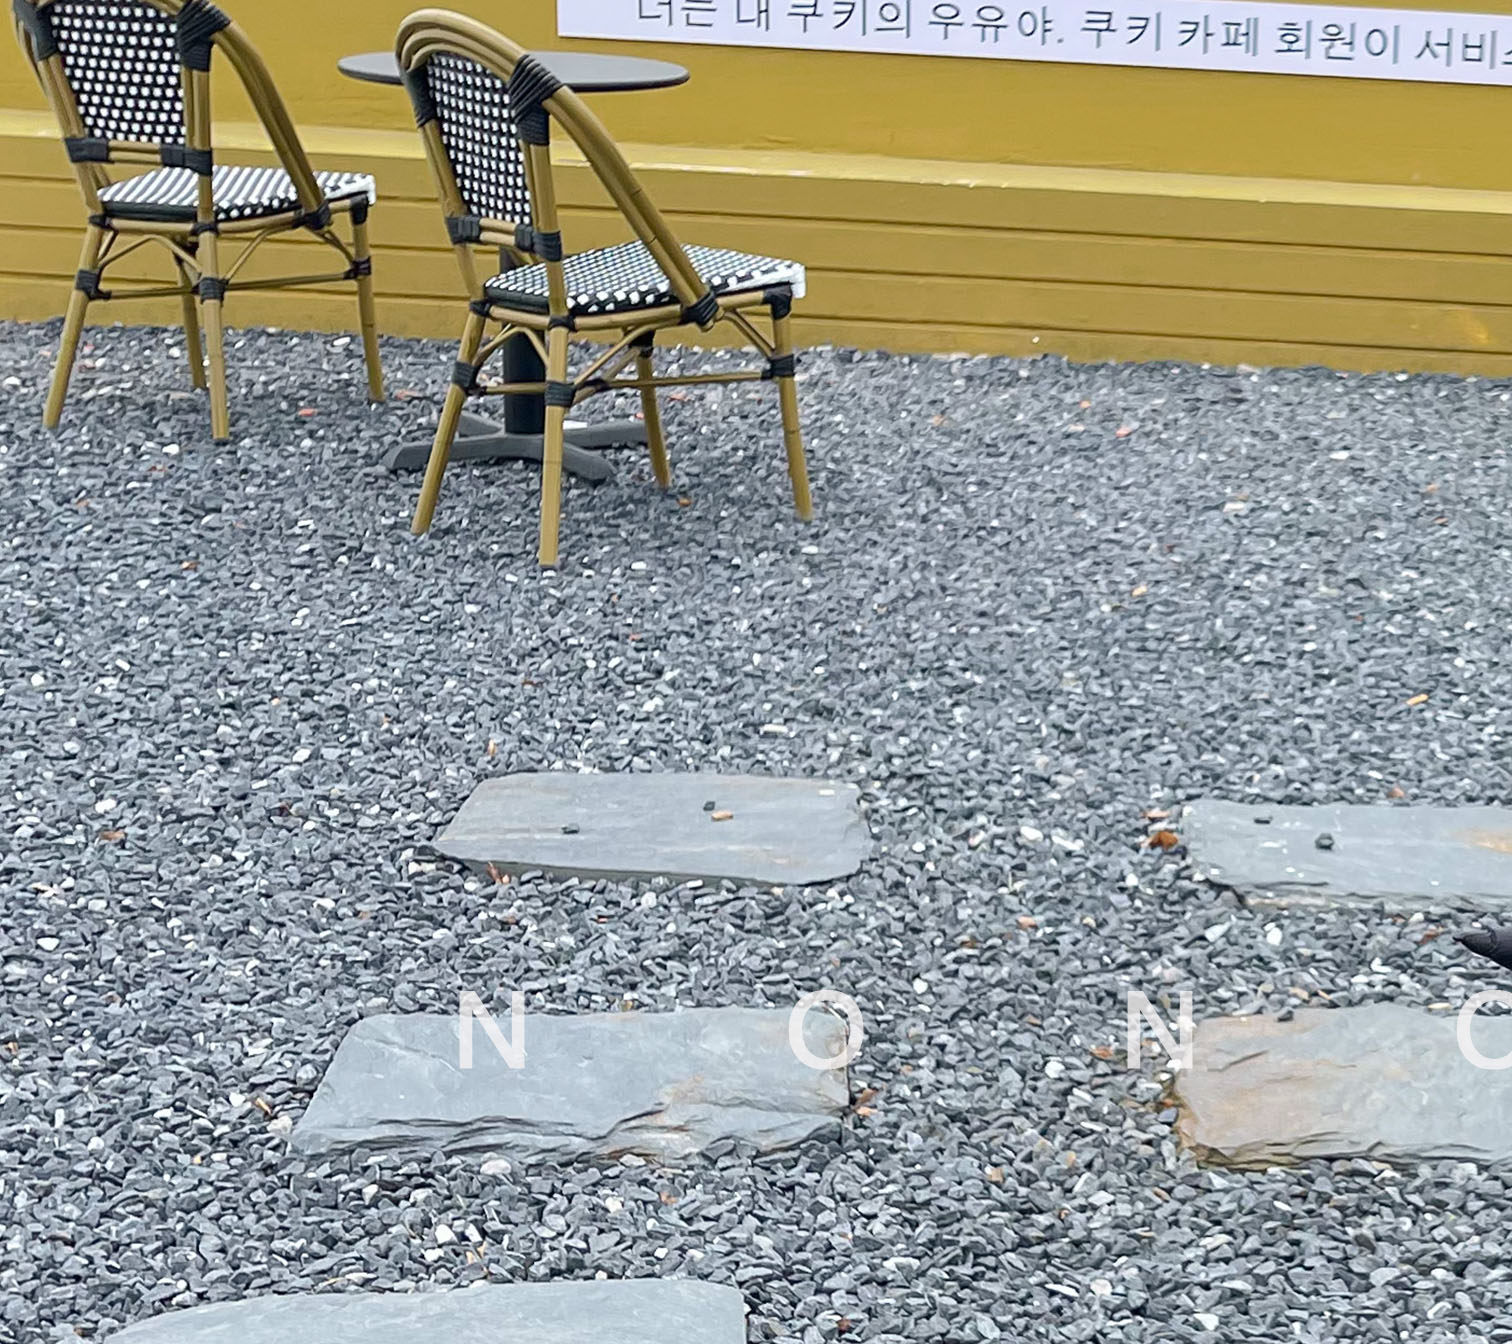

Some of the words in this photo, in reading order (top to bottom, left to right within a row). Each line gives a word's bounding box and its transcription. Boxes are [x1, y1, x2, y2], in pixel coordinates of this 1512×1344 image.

[927, 2, 1064, 46] 우유야.
[1080, 10, 1162, 51] 쿠키
[1177, 14, 1259, 57] 카페
[1273, 20, 1400, 65] 회원이
